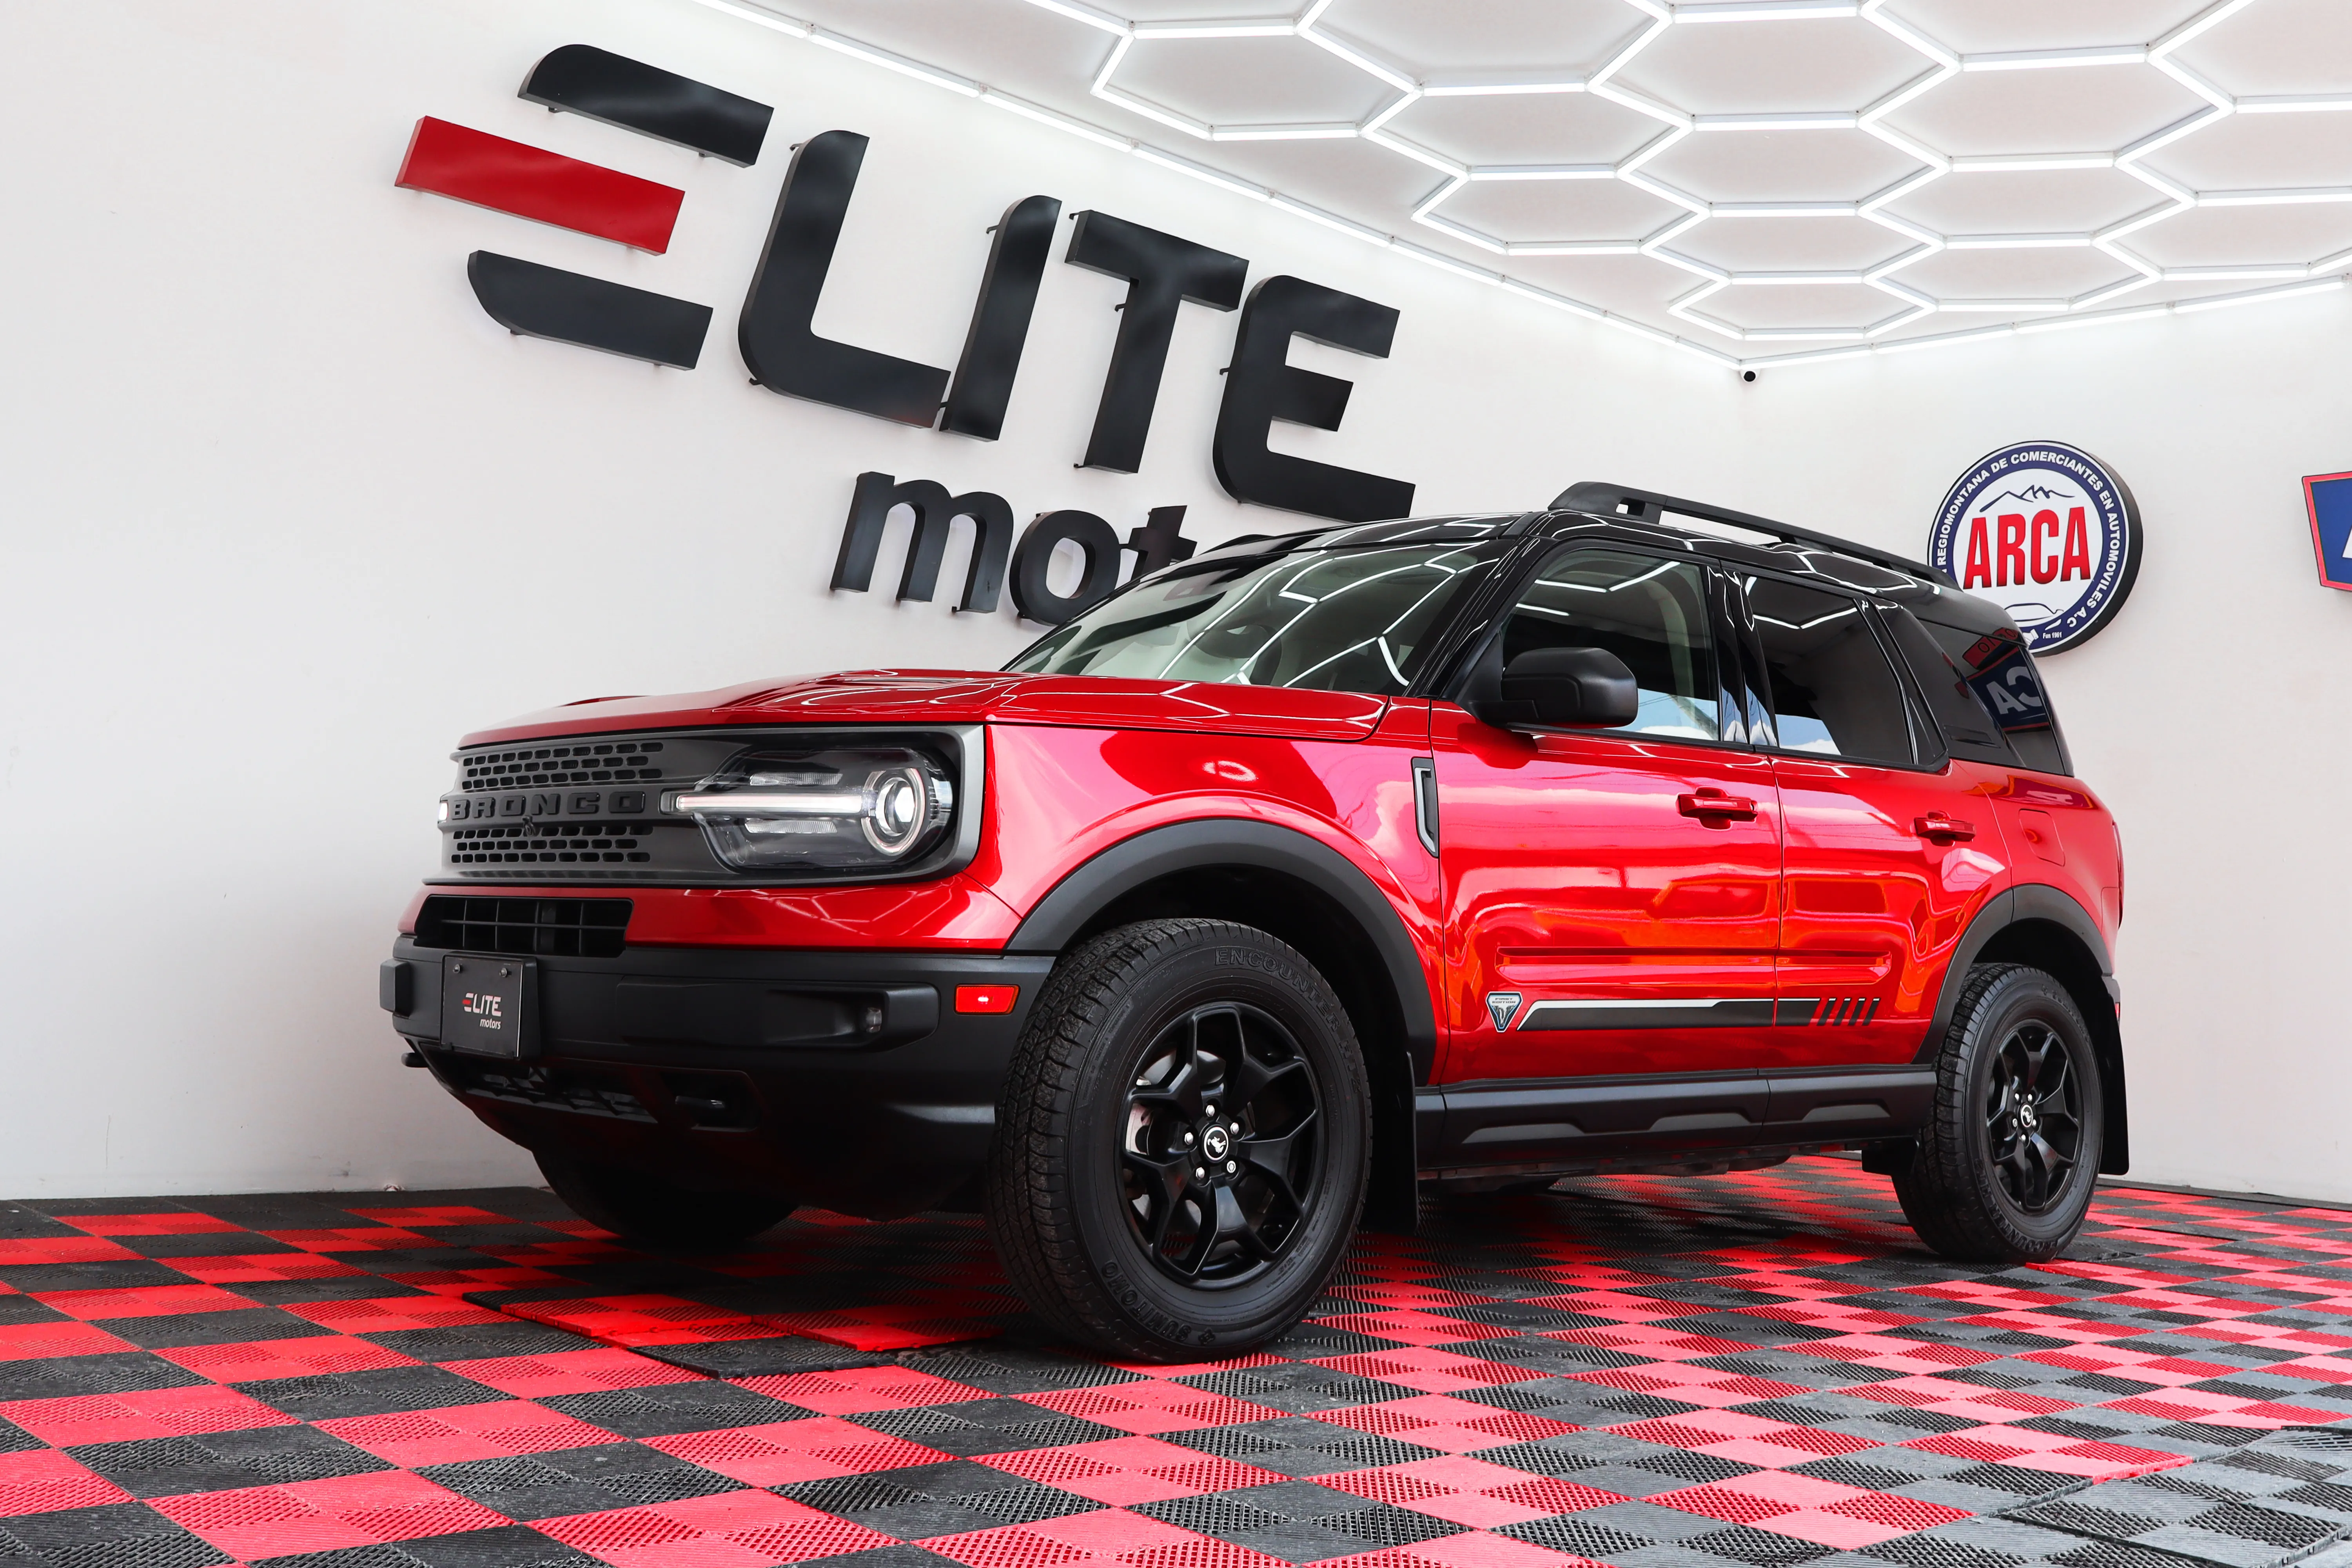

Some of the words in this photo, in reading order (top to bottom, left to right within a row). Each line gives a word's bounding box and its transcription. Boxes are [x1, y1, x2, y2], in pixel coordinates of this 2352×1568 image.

[395, 43, 1416, 522] ELITE
[1991, 458, 2008, 473] DE
[2011, 451, 2103, 490] COMERCIANTES
[1937, 469, 1990, 566] REGIOMONTANA
[2099, 490, 2114, 510] EN
[1963, 506, 2091, 590] ARCA
[2087, 513, 2121, 608] AUTOMOVILES
[451, 791, 646, 820] BRONCO
[462, 993, 502, 1017] ELITE
[1215, 948, 1340, 1033] ENCOUNTER
[479, 1018, 501, 1030] motors
[1101, 1261, 1192, 1341] SUMITOMO
